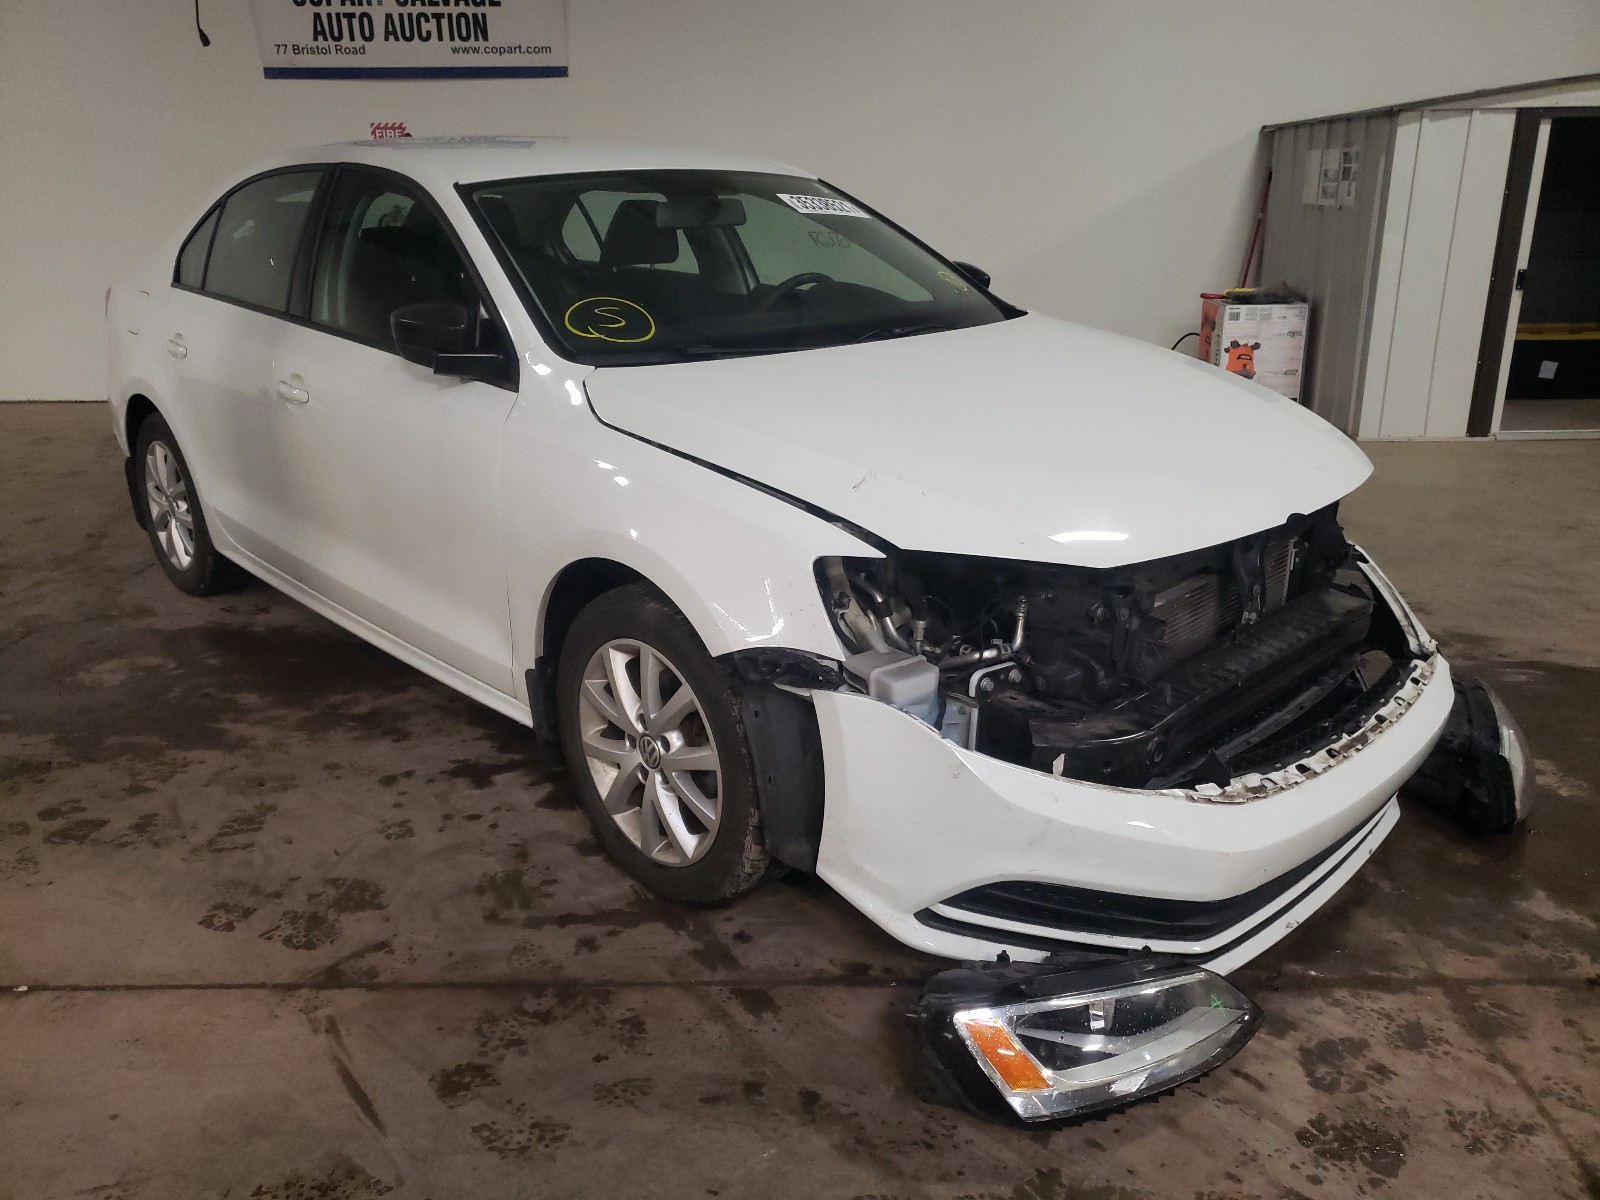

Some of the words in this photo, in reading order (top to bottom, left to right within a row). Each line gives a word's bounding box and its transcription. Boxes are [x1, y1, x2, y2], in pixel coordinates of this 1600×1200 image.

[312, 12, 375, 42] AUTO
[384, 12, 489, 42] AUCTION
[274, 44, 288, 55] 77
[292, 43, 332, 55] Bristol
[335, 44, 366, 55] Road
[450, 43, 552, 57] www.copart.com
[375, 129, 403, 139] FIRE
